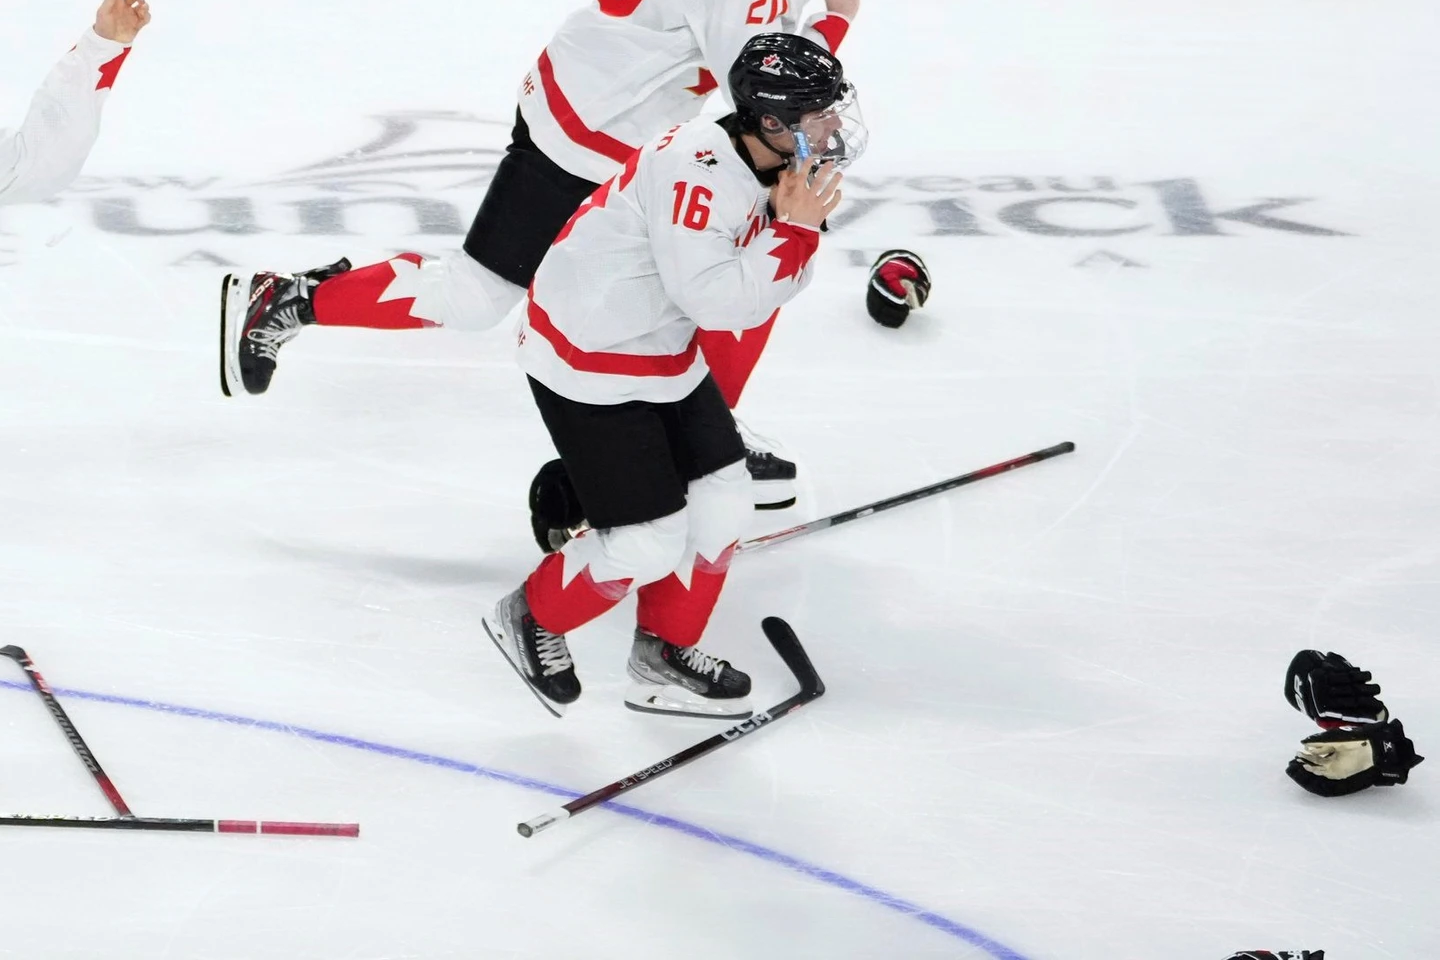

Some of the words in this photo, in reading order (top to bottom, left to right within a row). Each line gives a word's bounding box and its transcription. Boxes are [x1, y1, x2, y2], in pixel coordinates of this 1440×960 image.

[756, 91, 787, 101] BAUER
[671, 180, 714, 232] 16
[720, 710, 774, 742] CCM
